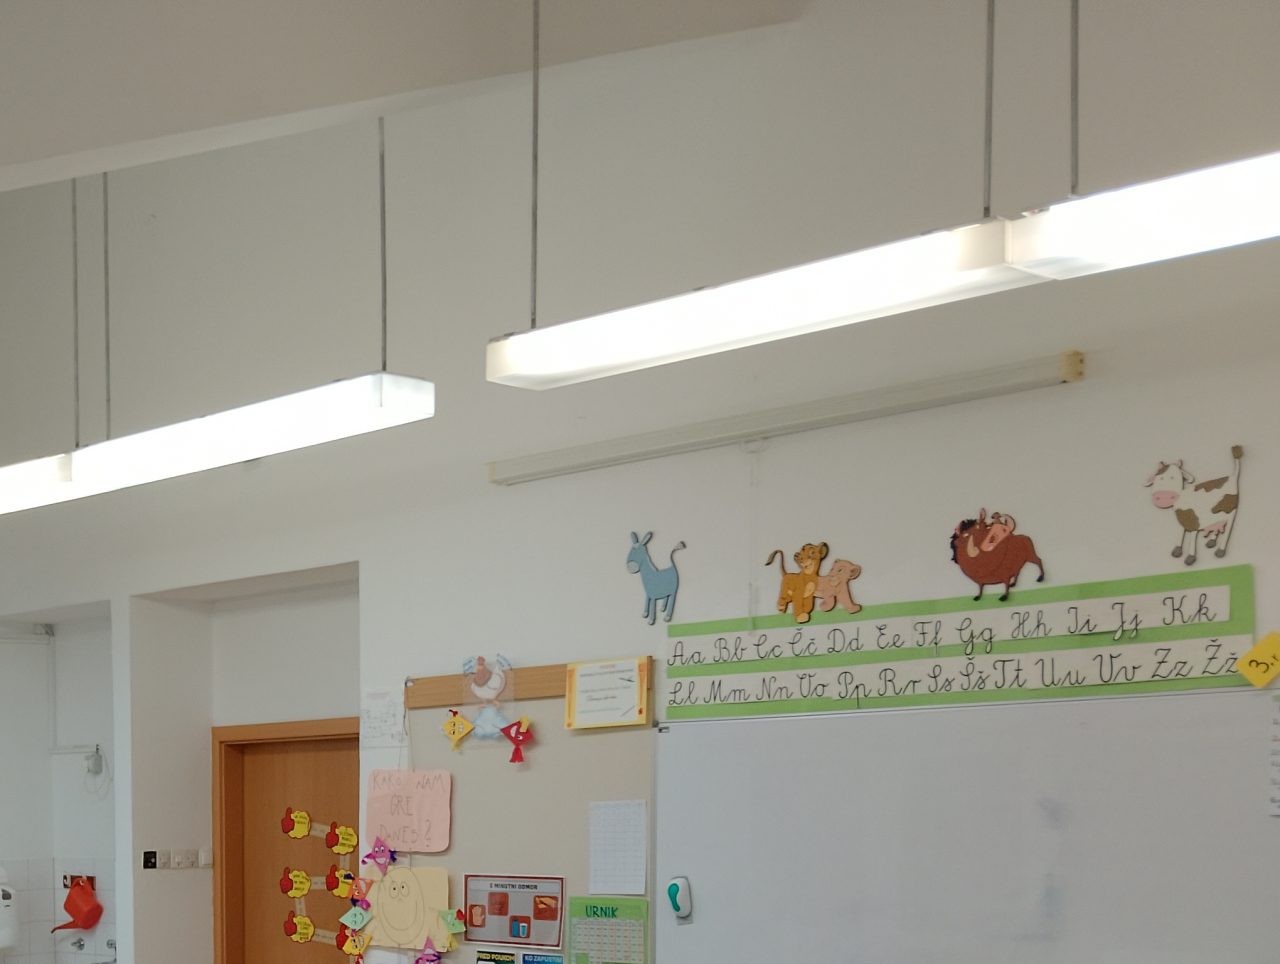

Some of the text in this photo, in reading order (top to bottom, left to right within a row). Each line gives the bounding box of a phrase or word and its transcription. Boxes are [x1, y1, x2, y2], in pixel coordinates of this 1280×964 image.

[667, 593, 1217, 666] Aa Bb Cc Čč Dd Ee Ff Gg Hh Ii Jj Kk
[669, 680, 698, 706] Ll
[703, 680, 751, 704] Mm
[755, 676, 793, 701] Nn
[797, 672, 829, 697] Oo
[837, 670, 871, 709] Pp
[877, 667, 921, 696] Rr
[927, 664, 956, 694] Ss
[959, 656, 991, 691] Šš
[992, 657, 1028, 689] Tt
[1034, 657, 1087, 688] Uu
[1093, 652, 1143, 683] Vv
[1150, 648, 1193, 679] Zz
[1201, 638, 1238, 675] Žž
[585, 905, 619, 918] URNIK
